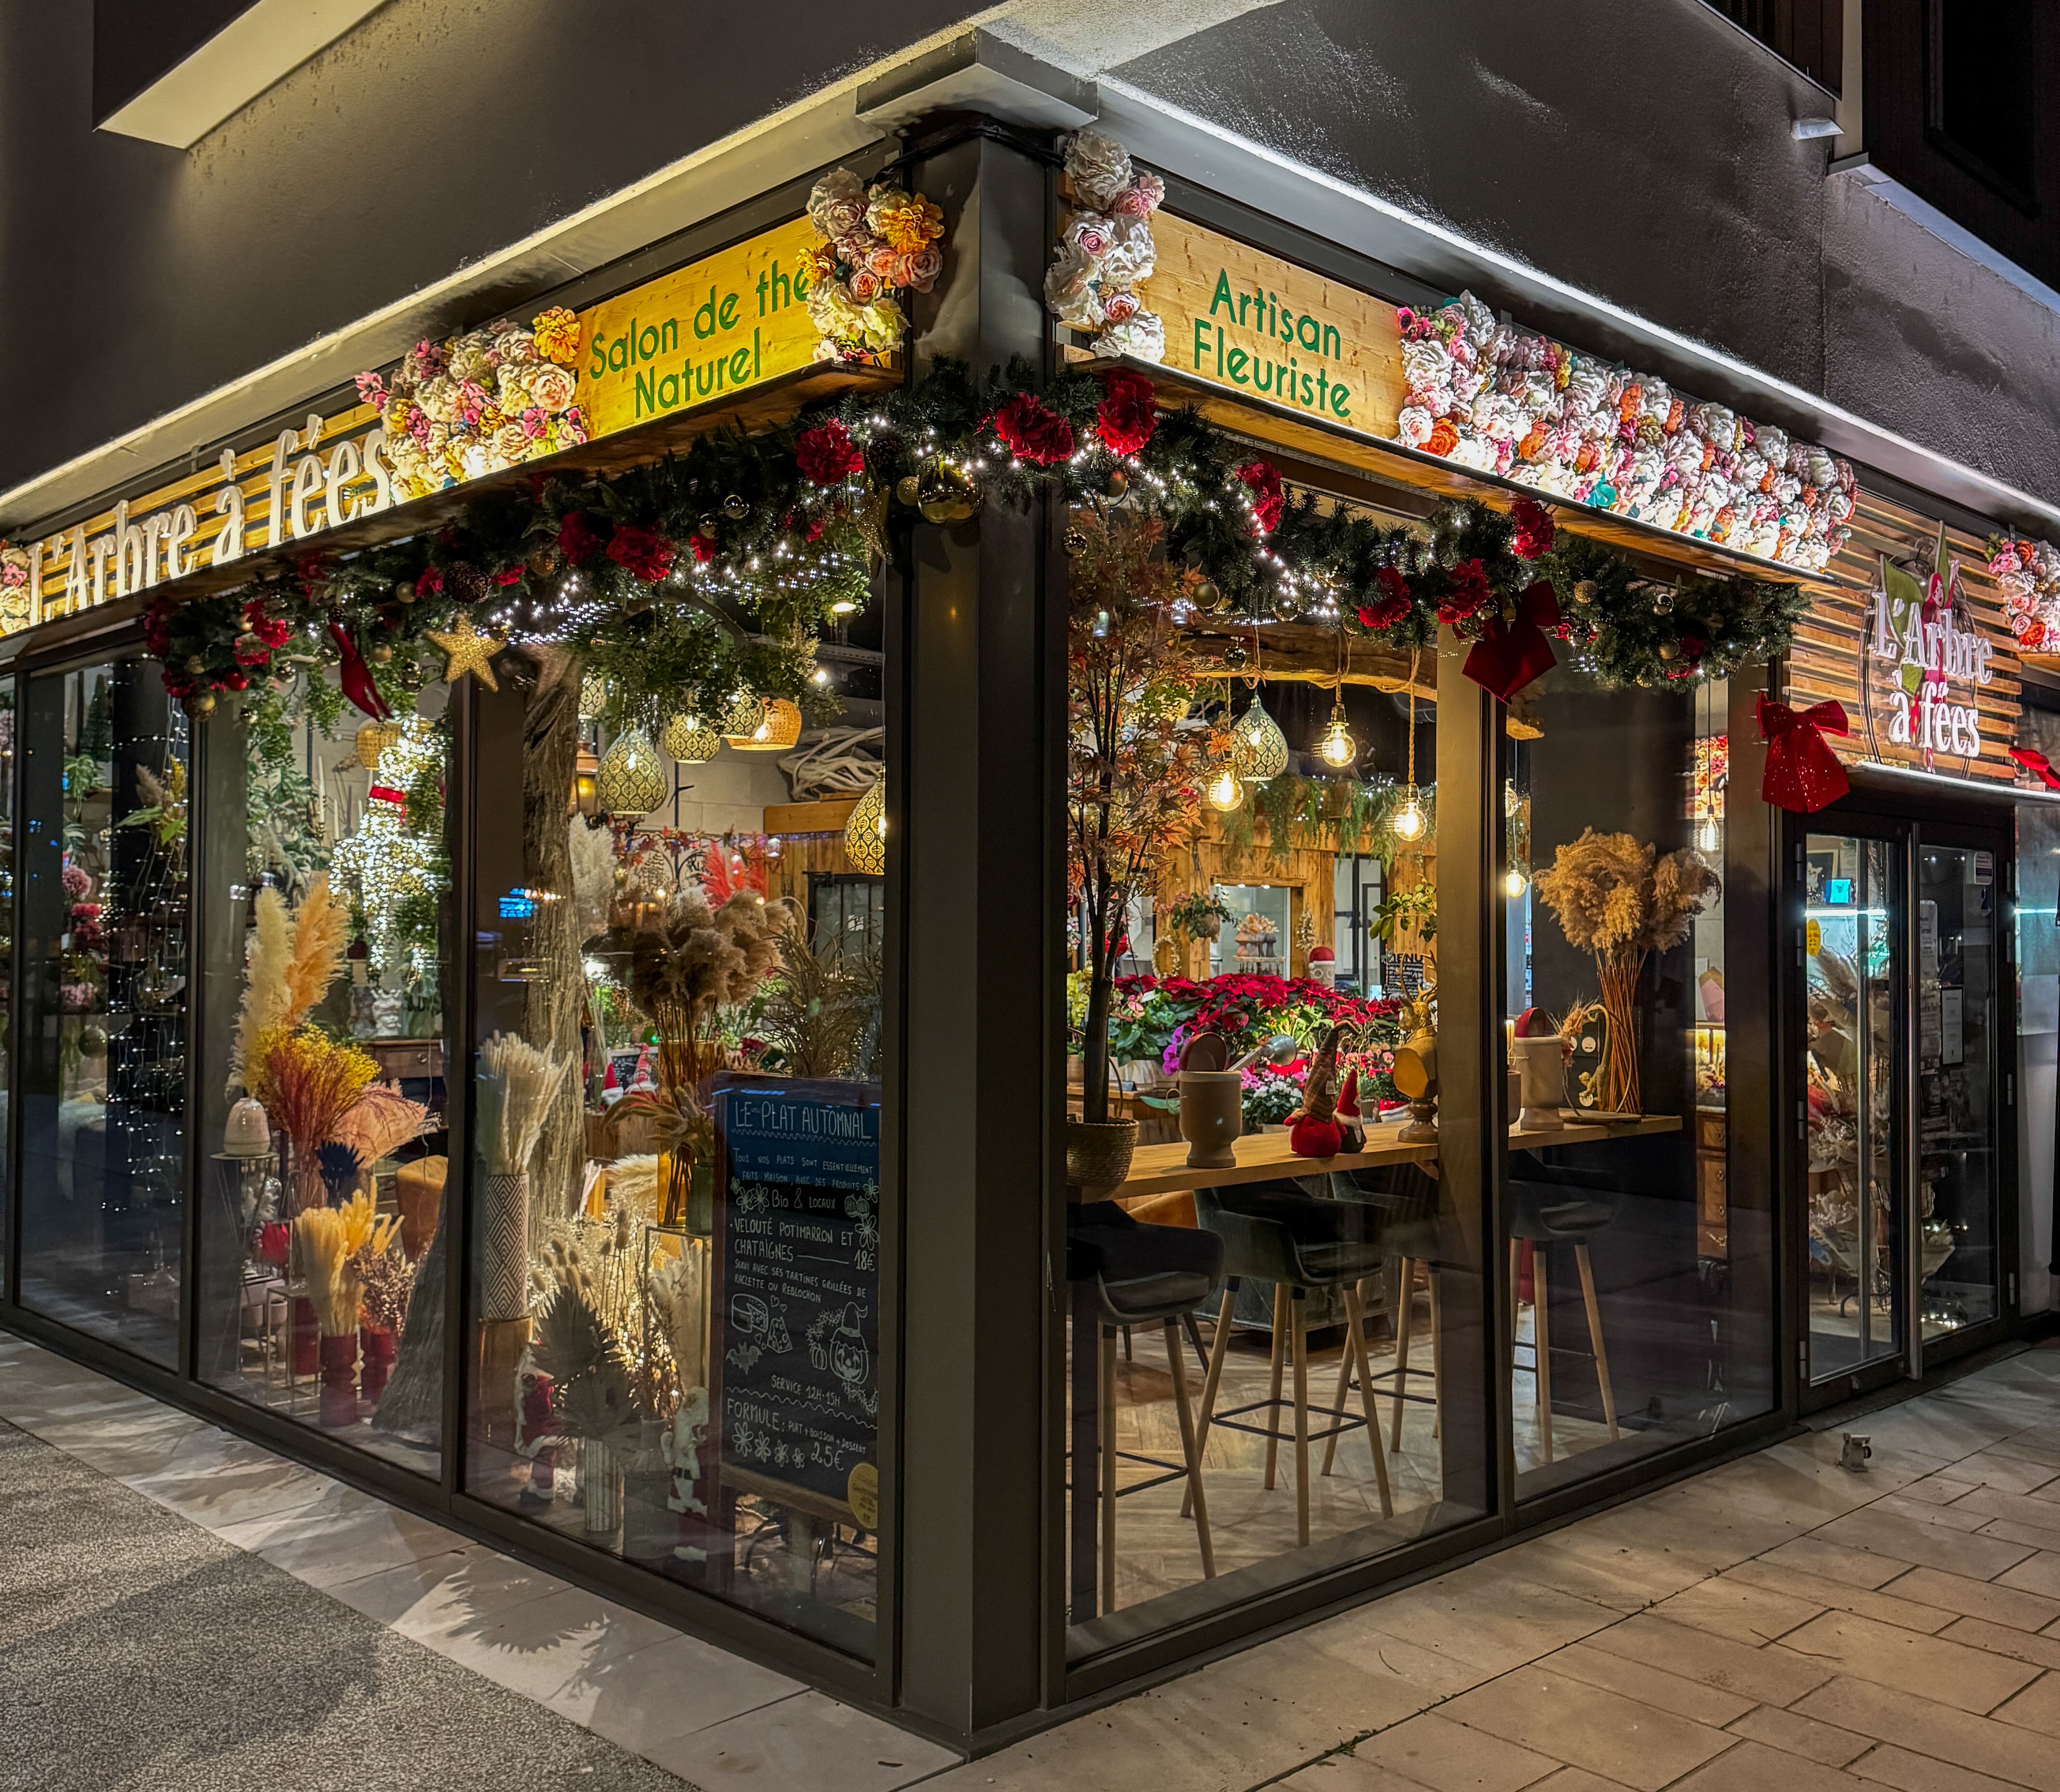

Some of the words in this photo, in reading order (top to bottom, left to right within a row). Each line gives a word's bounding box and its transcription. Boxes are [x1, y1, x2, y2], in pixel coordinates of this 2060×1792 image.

[1209, 267, 1341, 361] Artisan
[590, 317, 678, 380] Salon
[693, 284, 741, 340] de
[635, 327, 761, 418] Naturel
[1194, 318, 1351, 418] Fleuriste
[28, 500, 197, 627] L'Arbre
[212, 448, 244, 566] à
[268, 414, 392, 549] fées
[1867, 591, 1993, 685] L'Arbre
[1888, 669, 1911, 743] à
[1918, 681, 1981, 757] fées
[735, 1101, 753, 1127] LE
[762, 1101, 796, 1130] PLAT
[802, 1107, 871, 1139] AUTOMNAL
[742, 1171, 758, 1180] FAITS
[795, 1175, 810, 1185] AVEC
[815, 1178, 826, 1187] DES
[832, 1179, 860, 1191] PRODUITS
[777, 1154, 794, 1165] PLATS
[823, 1161, 873, 1175] ESSENTIELLEMENT
[794, 1188, 803, 1209] &
[809, 1197, 836, 1209] LOCAUX
[734, 1217, 773, 1236] VELOUTÉ
[779, 1222, 833, 1244] POTIMARRON
[841, 1231, 854, 1246] ET
[854, 1249, 875, 1272] 18€
[734, 1273, 764, 1289] RACLETTE
[768, 1282, 779, 1291] OU
[782, 1282, 821, 1303] REBLOCHON
[752, 1263, 768, 1275] AVEC
[772, 1266, 783, 1278] SES
[786, 1269, 818, 1287] TARTINES
[822, 1279, 852, 1295] GRILLÉES
[856, 1287, 867, 1298] DE
[771, 1375, 802, 1395] SERVICE
[788, 1420, 803, 1435] PLAT
[809, 1428, 835, 1442] BOISSON
[842, 1438, 866, 1455] DESSERT
[811, 1442, 843, 1471] 25€
